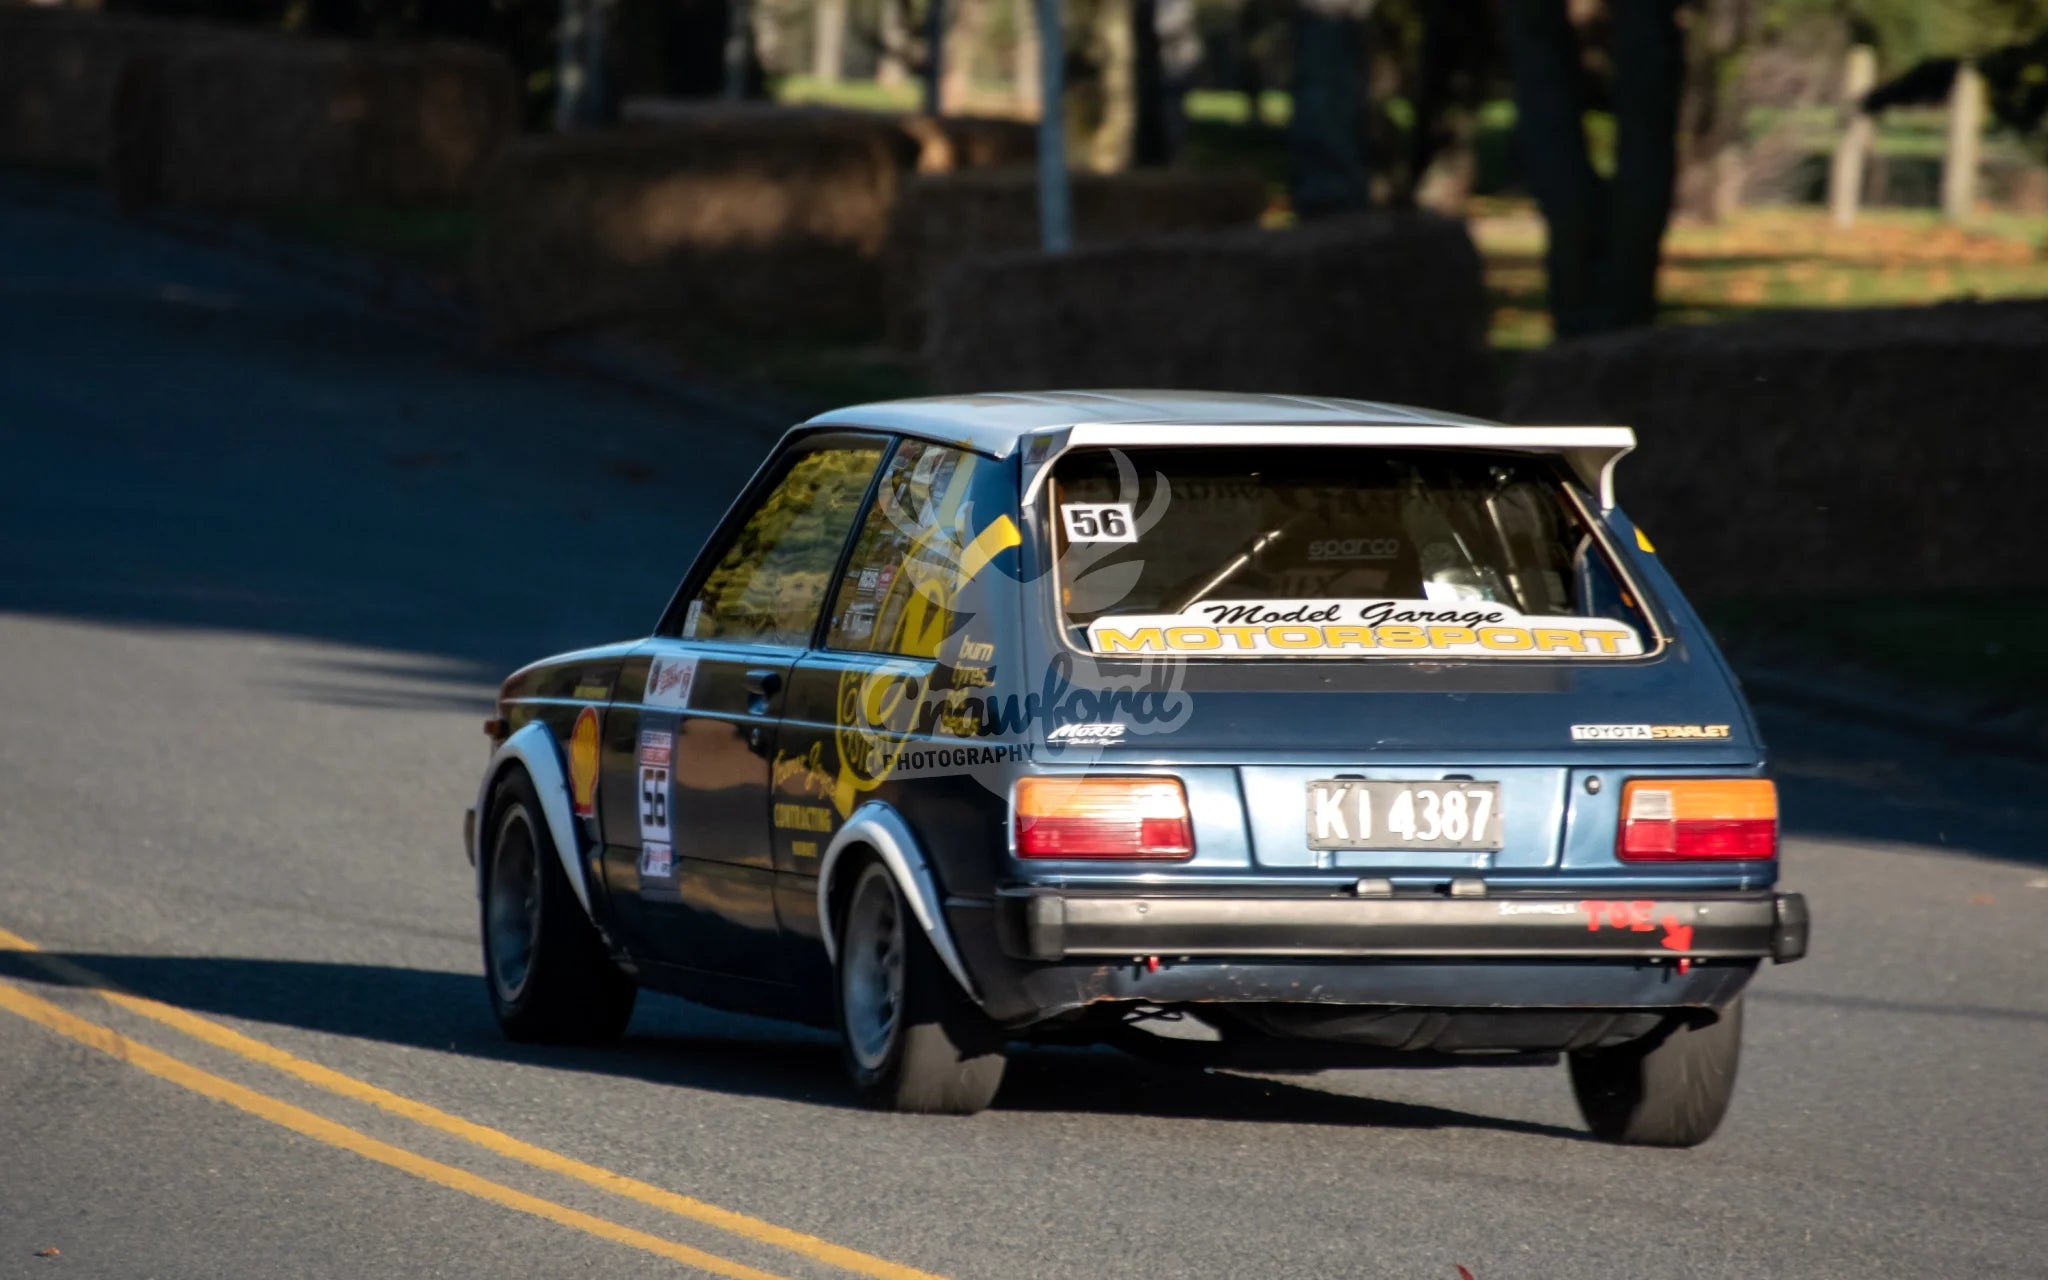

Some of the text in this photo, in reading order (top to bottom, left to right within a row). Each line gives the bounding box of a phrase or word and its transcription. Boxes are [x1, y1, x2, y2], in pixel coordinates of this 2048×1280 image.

[1070, 508, 1127, 538] 56
[1309, 539, 1399, 557] sparco
[1202, 603, 1505, 629] Model Garage
[958, 634, 995, 662] burn
[1096, 624, 1631, 655] MOTORSPORT
[1576, 725, 1731, 738] TOYOTA STARLET
[1388, 789, 1495, 842] 4387
[1579, 899, 1657, 932] TOE
